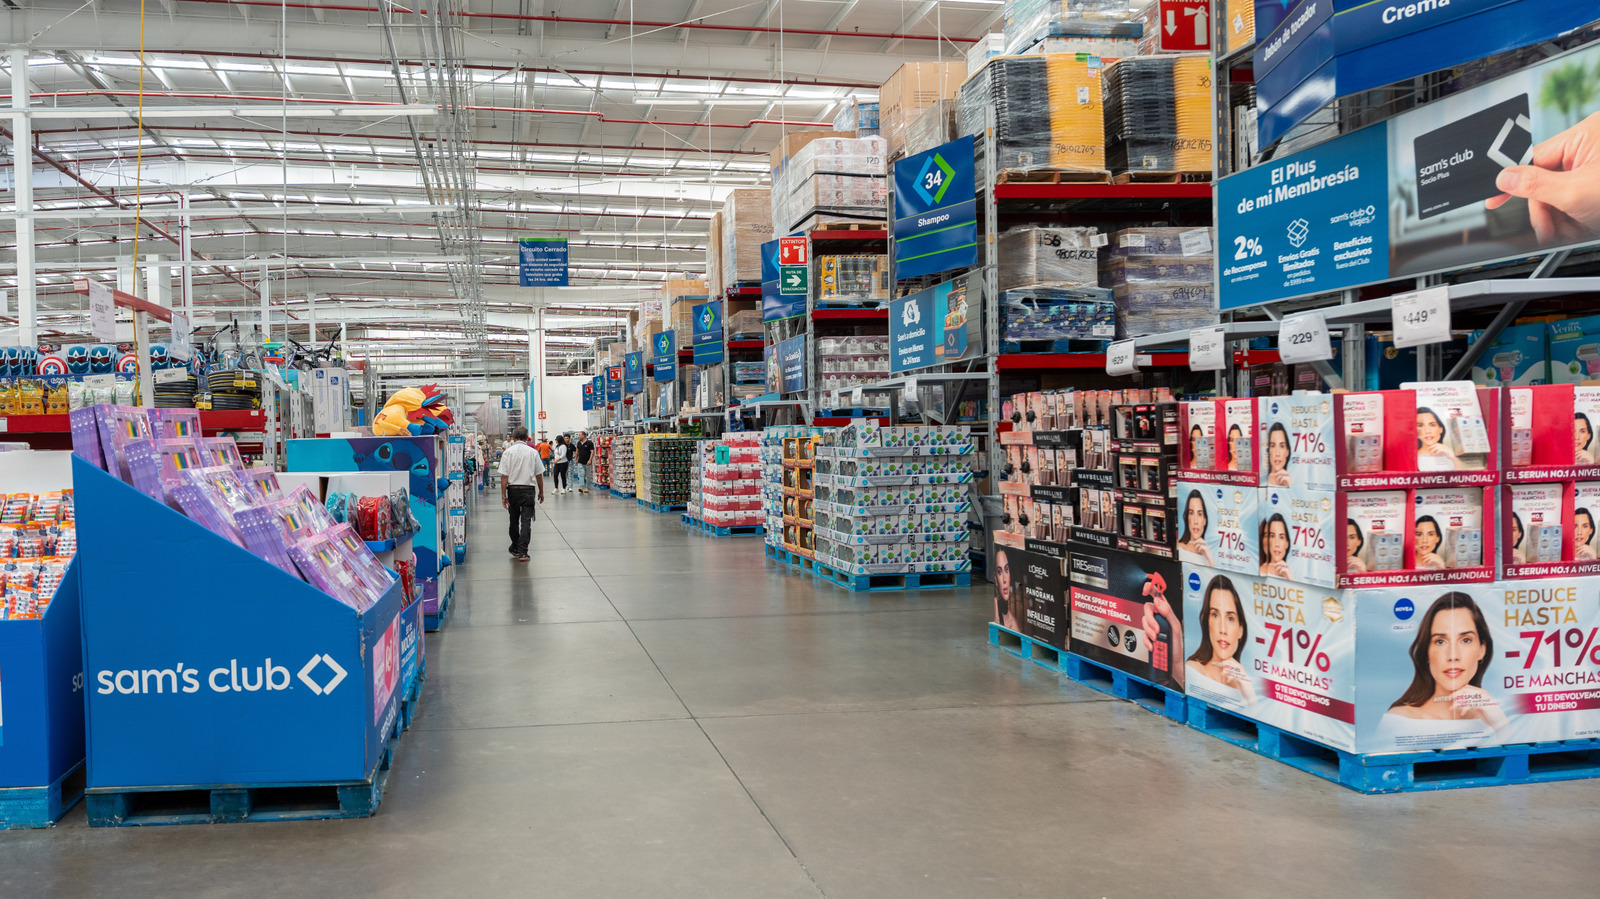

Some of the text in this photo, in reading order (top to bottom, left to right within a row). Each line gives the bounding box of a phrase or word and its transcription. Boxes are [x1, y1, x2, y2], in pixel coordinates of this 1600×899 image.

[1263, 2, 1316, 61] Jabón de tocador
[1420, 148, 1474, 177] sam's club
[925, 170, 942, 189] 34
[1271, 160, 1316, 185] El Plus
[1420, 172, 1450, 186] Socio Plus
[1237, 164, 1359, 214] de mi Membresía
[917, 213, 949, 227] Shampoo
[1350, 208, 1366, 220] club
[1234, 235, 1263, 260] 2%
[1334, 236, 1372, 250] Beneficios
[1278, 247, 1320, 263] Envíos Gratis
[1334, 247, 1372, 261] exclusivos
[1224, 261, 1267, 276] de Recompensa
[1283, 259, 1315, 272] Ilimitados
[1356, 258, 1370, 266] Club
[1291, 406, 1318, 414] REDUCE
[1292, 419, 1318, 428] HASTA
[1292, 432, 1325, 453] 71%
[1292, 457, 1300, 465] DE
[1078, 473, 1112, 481] MAYBELLINE
[1507, 471, 1516, 479] EL
[1518, 470, 1548, 479] SERUM
[1550, 469, 1569, 477] NO.1
[1578, 467, 1600, 476] NIVEL
[1341, 479, 1353, 487] EL
[1354, 478, 1387, 486] SERUM
[1389, 477, 1410, 485] NO.1
[1421, 475, 1445, 483] NIVEL
[1292, 500, 1318, 509] REDUCE
[1218, 508, 1239, 517] REDUCE
[1292, 513, 1319, 523] HASTA
[1218, 519, 1239, 529] HASTA
[1075, 531, 1109, 542] MAYBELLINE
[1218, 531, 1244, 551] 71%
[1292, 526, 1325, 549] 71%
[1029, 543, 1059, 553] MAYBELLINE
[1507, 568, 1517, 576] EL
[1519, 567, 1548, 575] SERUM
[1551, 566, 1569, 574] NO.1
[1578, 564, 1600, 573] NIVEL
[1341, 577, 1351, 585] EL
[1353, 575, 1386, 583] SERUM
[1388, 575, 1409, 583] NO.1
[1419, 573, 1444, 581] NIVEL
[1026, 587, 1054, 602] PANORAMA
[1074, 592, 1117, 609] 2PACK SPRAY DE
[1253, 582, 1304, 604] REDUCE
[1504, 587, 1577, 605] REDUCE
[1027, 609, 1055, 626] INFAILLIBLE
[1075, 600, 1131, 622] PROTECCIÓN TÉRMICA
[1254, 599, 1306, 625] HASTA
[1504, 606, 1578, 627] HASTA
[1256, 622, 1330, 672] -71%
[1505, 627, 1600, 669] -71%
[1254, 658, 1268, 673] DE
[97, 657, 290, 694] sam's club
[1504, 675, 1525, 689] DE
[1275, 692, 1306, 708] TU DINERO
[1281, 685, 1289, 694] TE
[1290, 686, 1330, 707] DEVOLVEMOS
[1535, 695, 1542, 703] O
[1543, 694, 1553, 702] TE
[1536, 701, 1577, 711] TU DINERO
